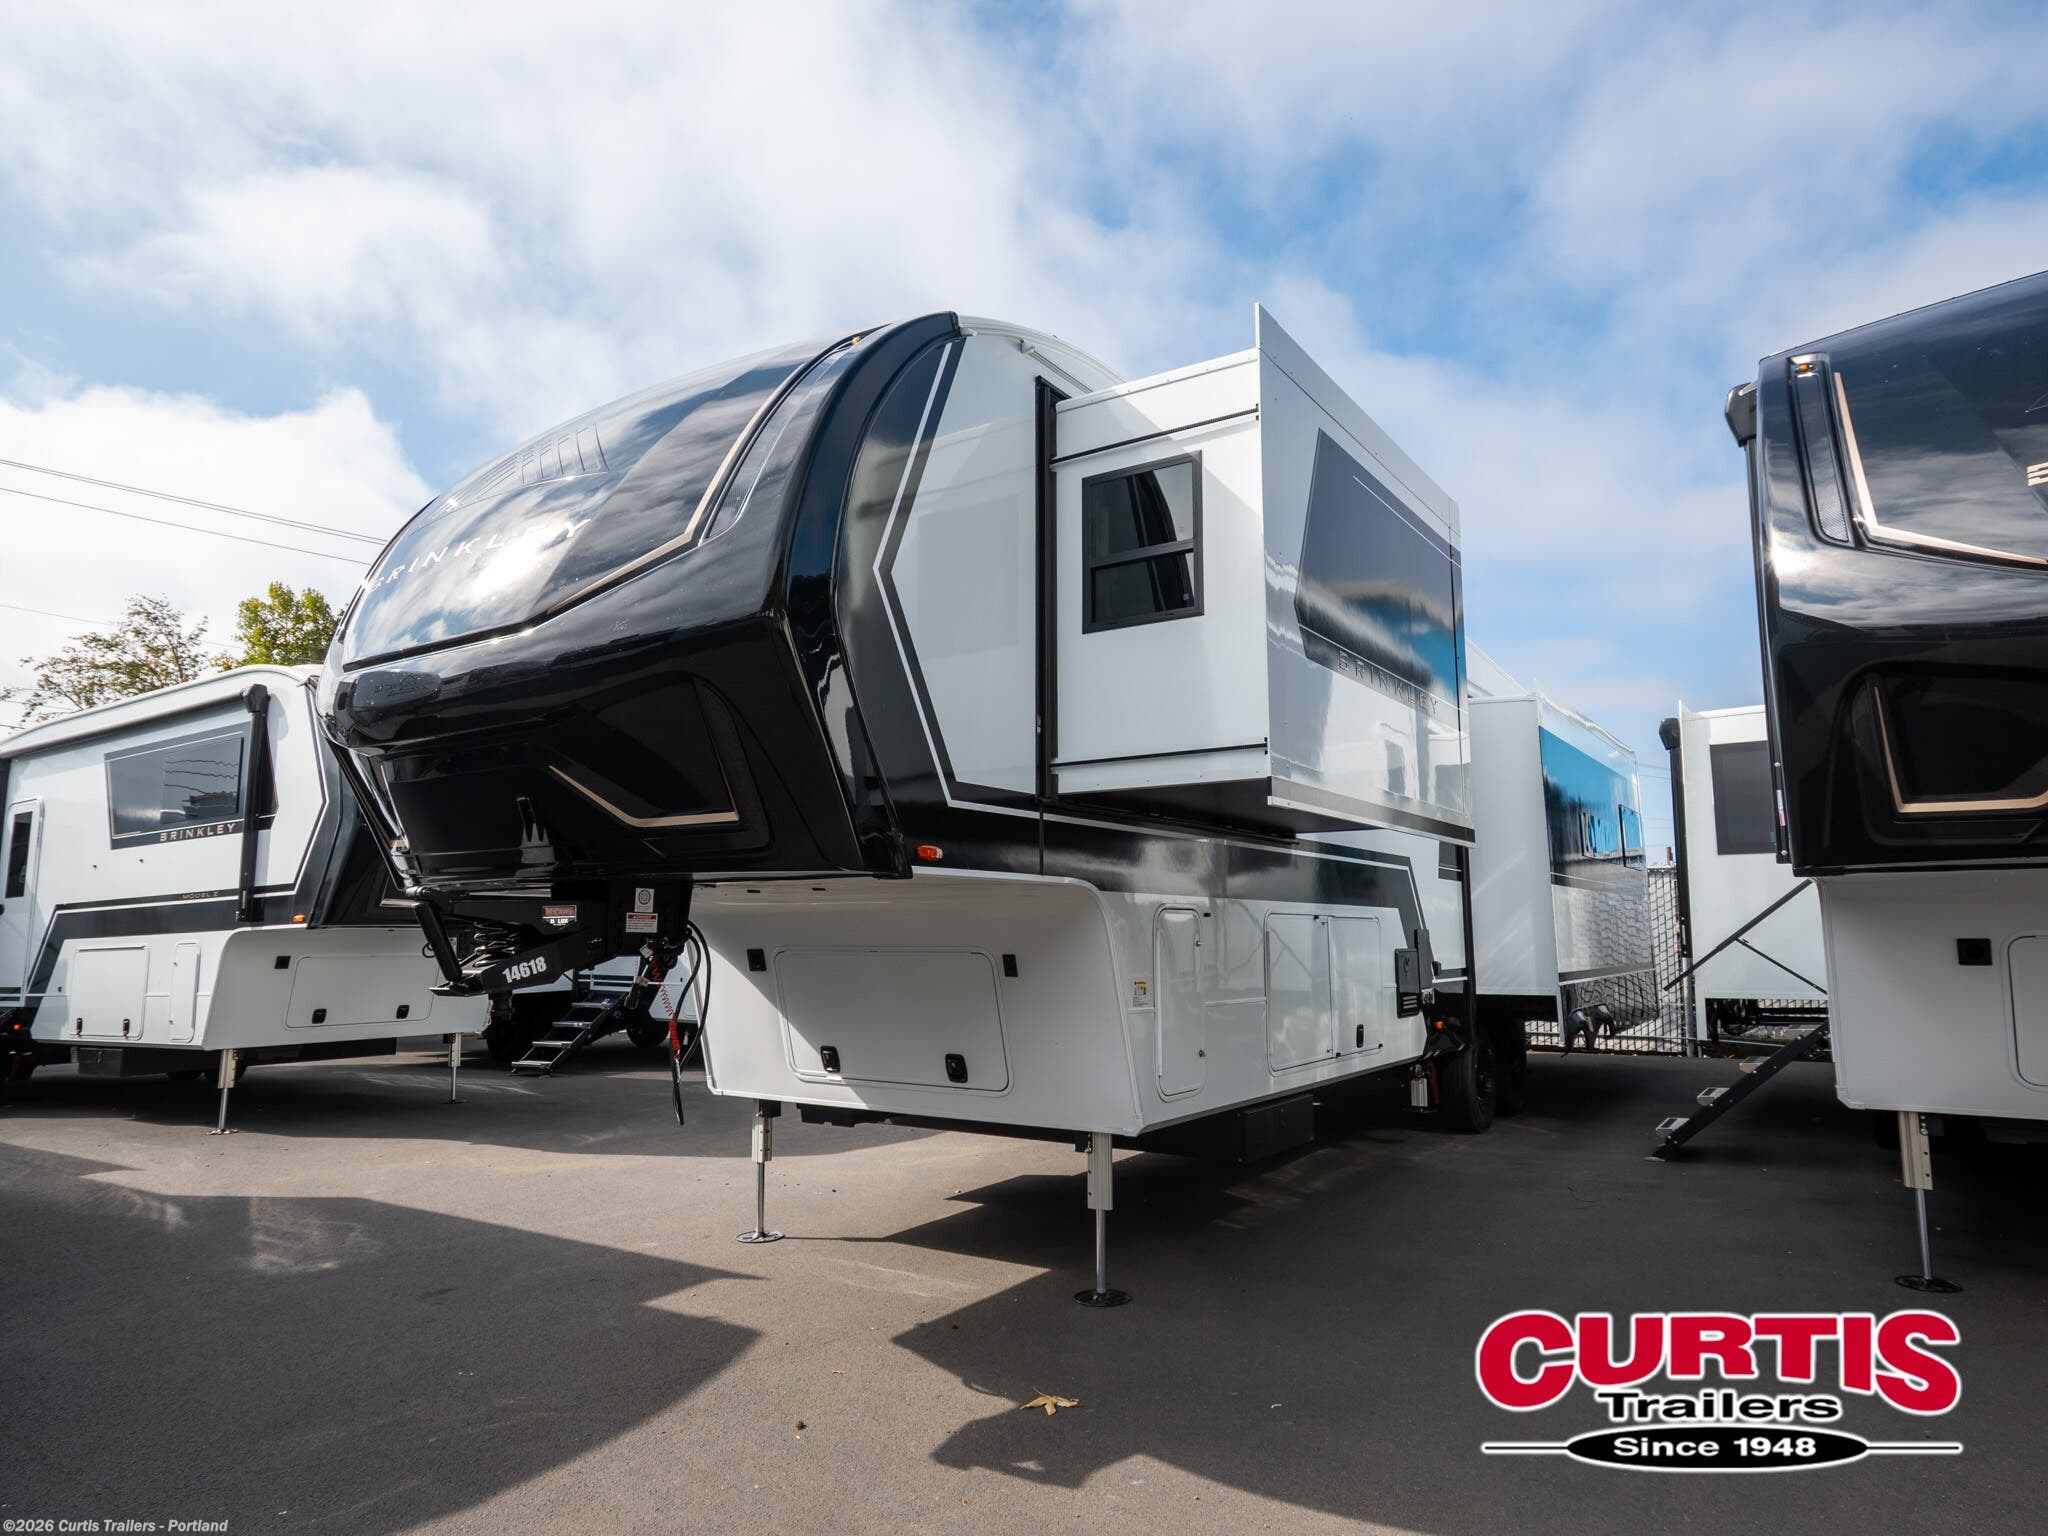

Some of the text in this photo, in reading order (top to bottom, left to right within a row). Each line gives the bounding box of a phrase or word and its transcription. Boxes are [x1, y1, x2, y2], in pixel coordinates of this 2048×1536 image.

[1338, 650, 1439, 714] BRINKLEY
[160, 823, 236, 842] BRINKLEY
[502, 956, 547, 984] 14618
